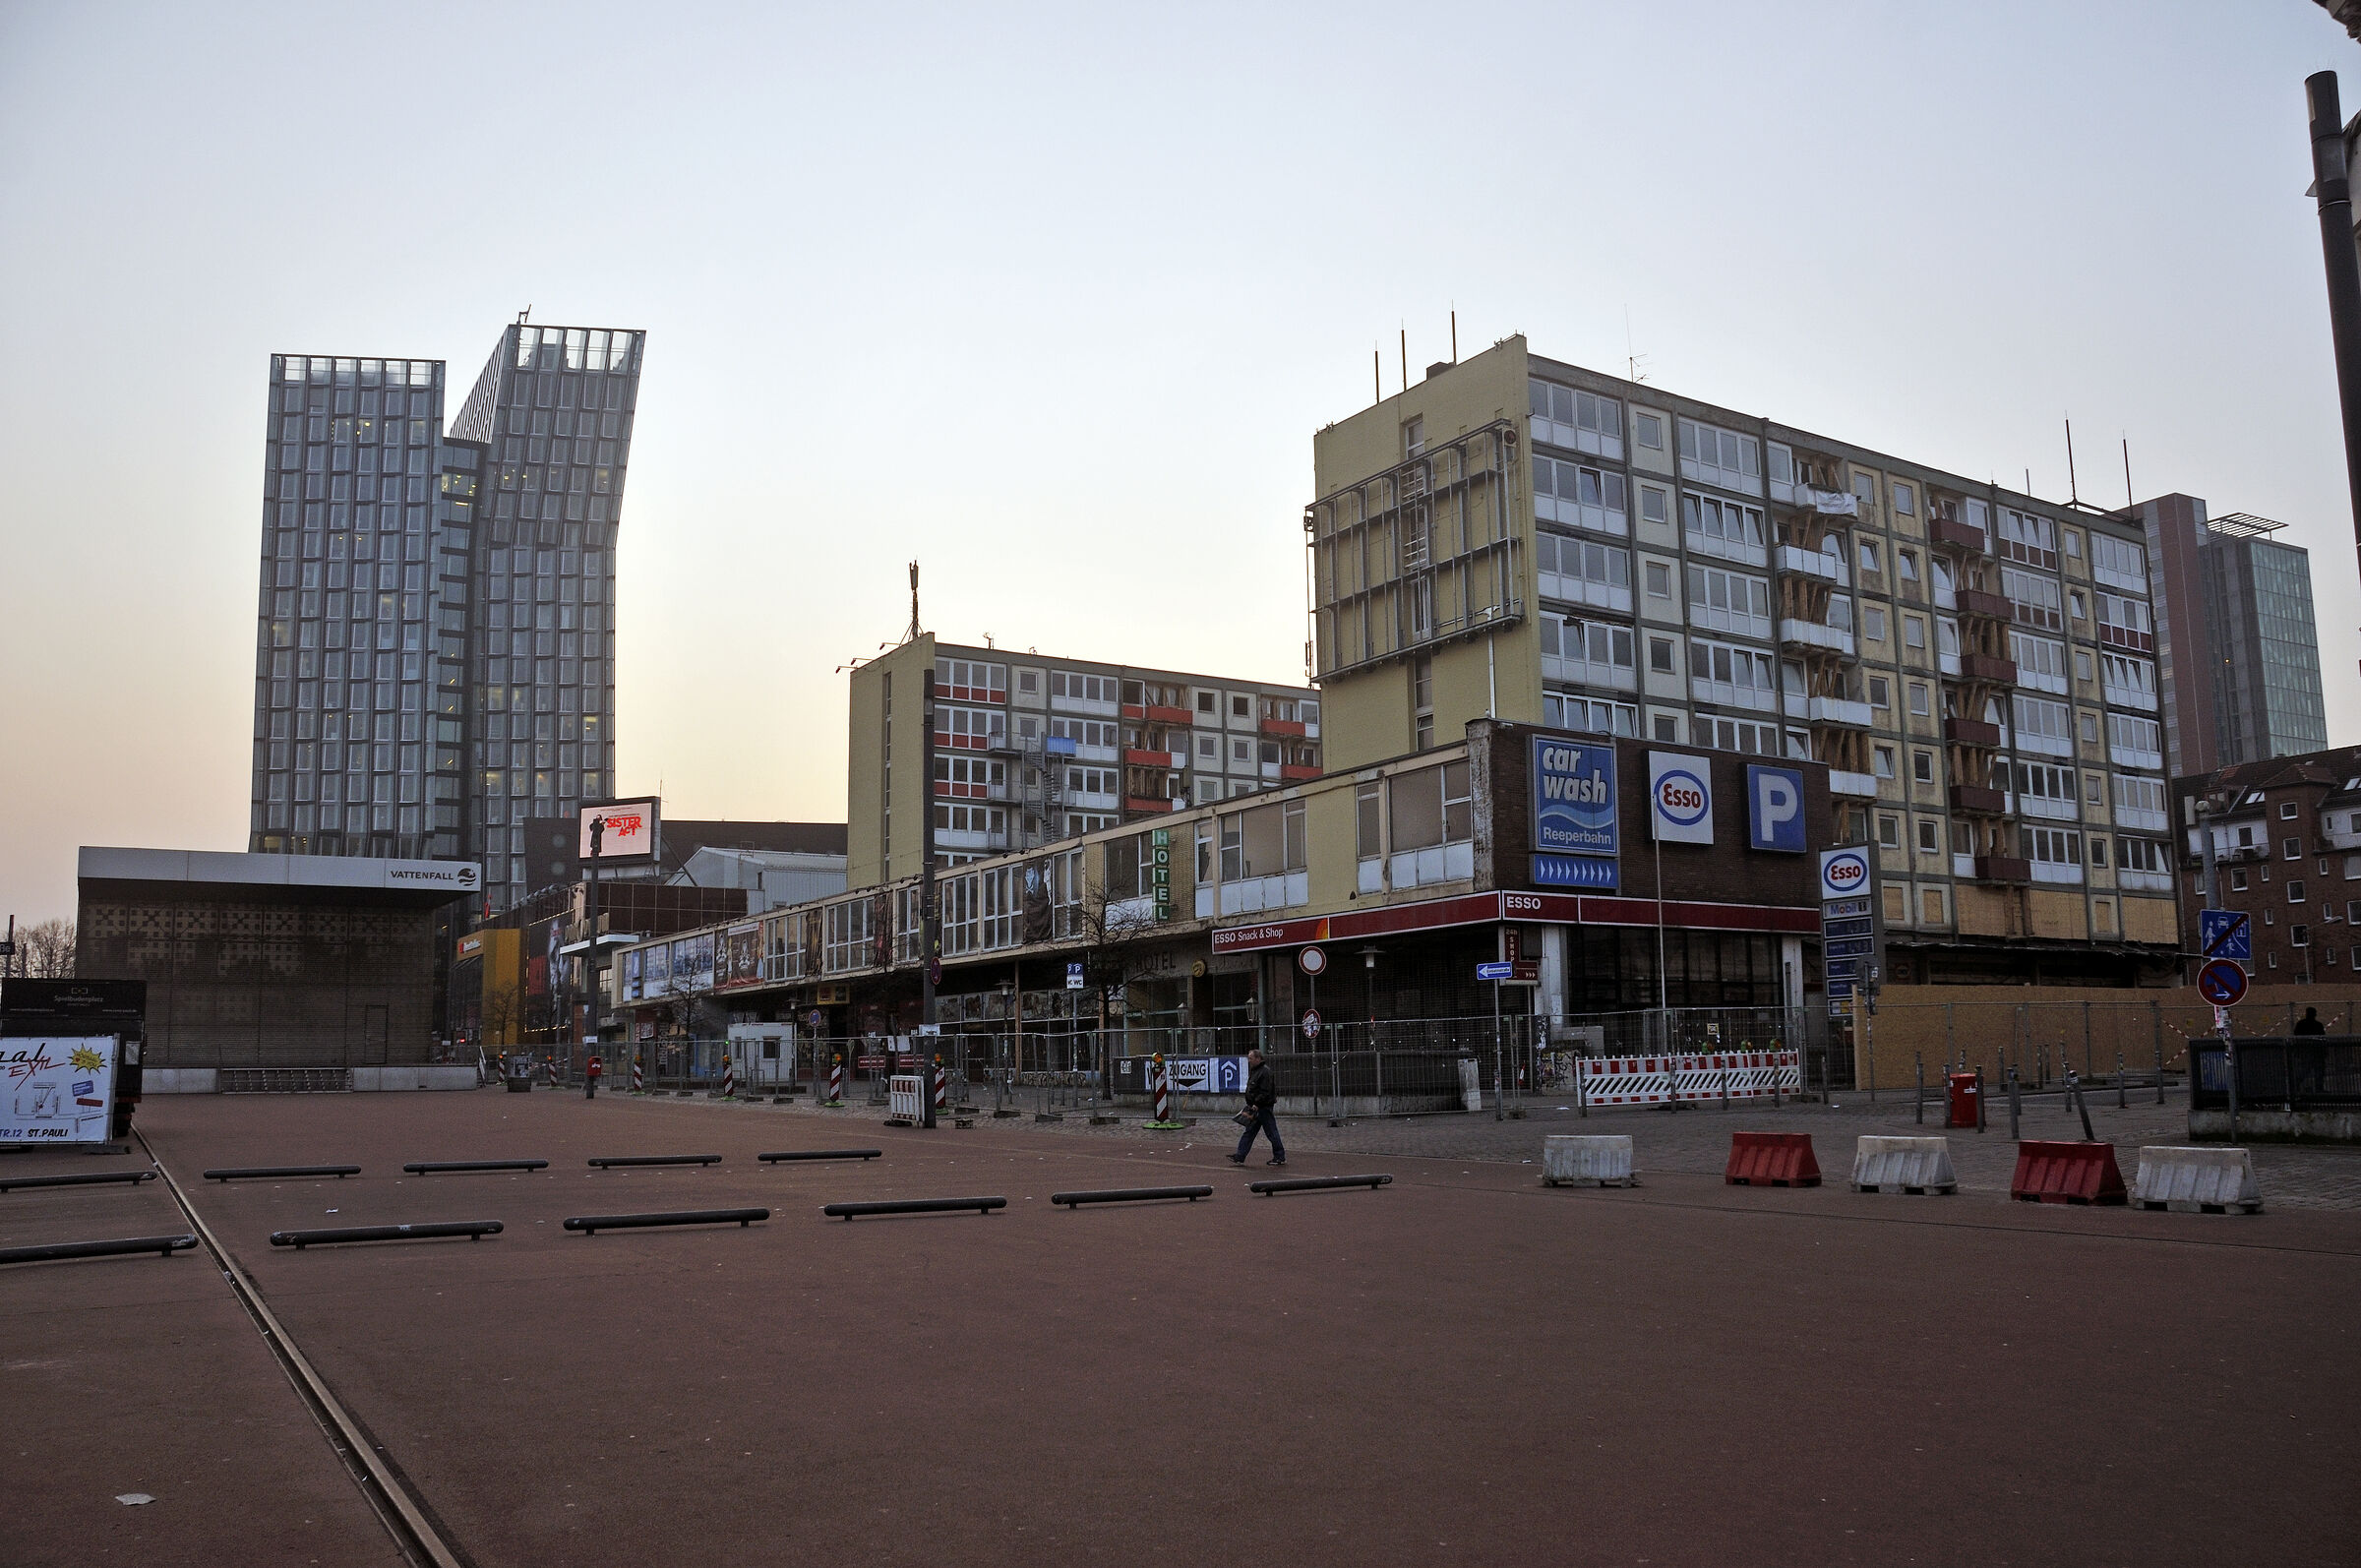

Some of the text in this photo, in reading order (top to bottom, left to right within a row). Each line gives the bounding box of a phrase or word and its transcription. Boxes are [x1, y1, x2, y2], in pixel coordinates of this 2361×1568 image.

[1543, 746, 1582, 772] car
[1544, 769, 1607, 804] wash
[1663, 783, 1701, 809] Esso
[1758, 772, 1798, 842] P
[606, 816, 642, 828] SISTER
[618, 826, 637, 837] ACT
[1543, 826, 1611, 845] Reeperbahn
[391, 871, 454, 880] VATTENFALL
[1157, 830, 1170, 921] HOTEL
[1831, 865, 1861, 880] Esso
[1506, 896, 1542, 910] ESSO
[1831, 902, 1857, 915] Mobil
[1214, 927, 1284, 944] ESSO Snack & Shop
[1169, 1063, 1206, 1076] ZUGANG
[1225, 1068, 1234, 1088] P
[28, 1128, 69, 1137] ST.PAULI
